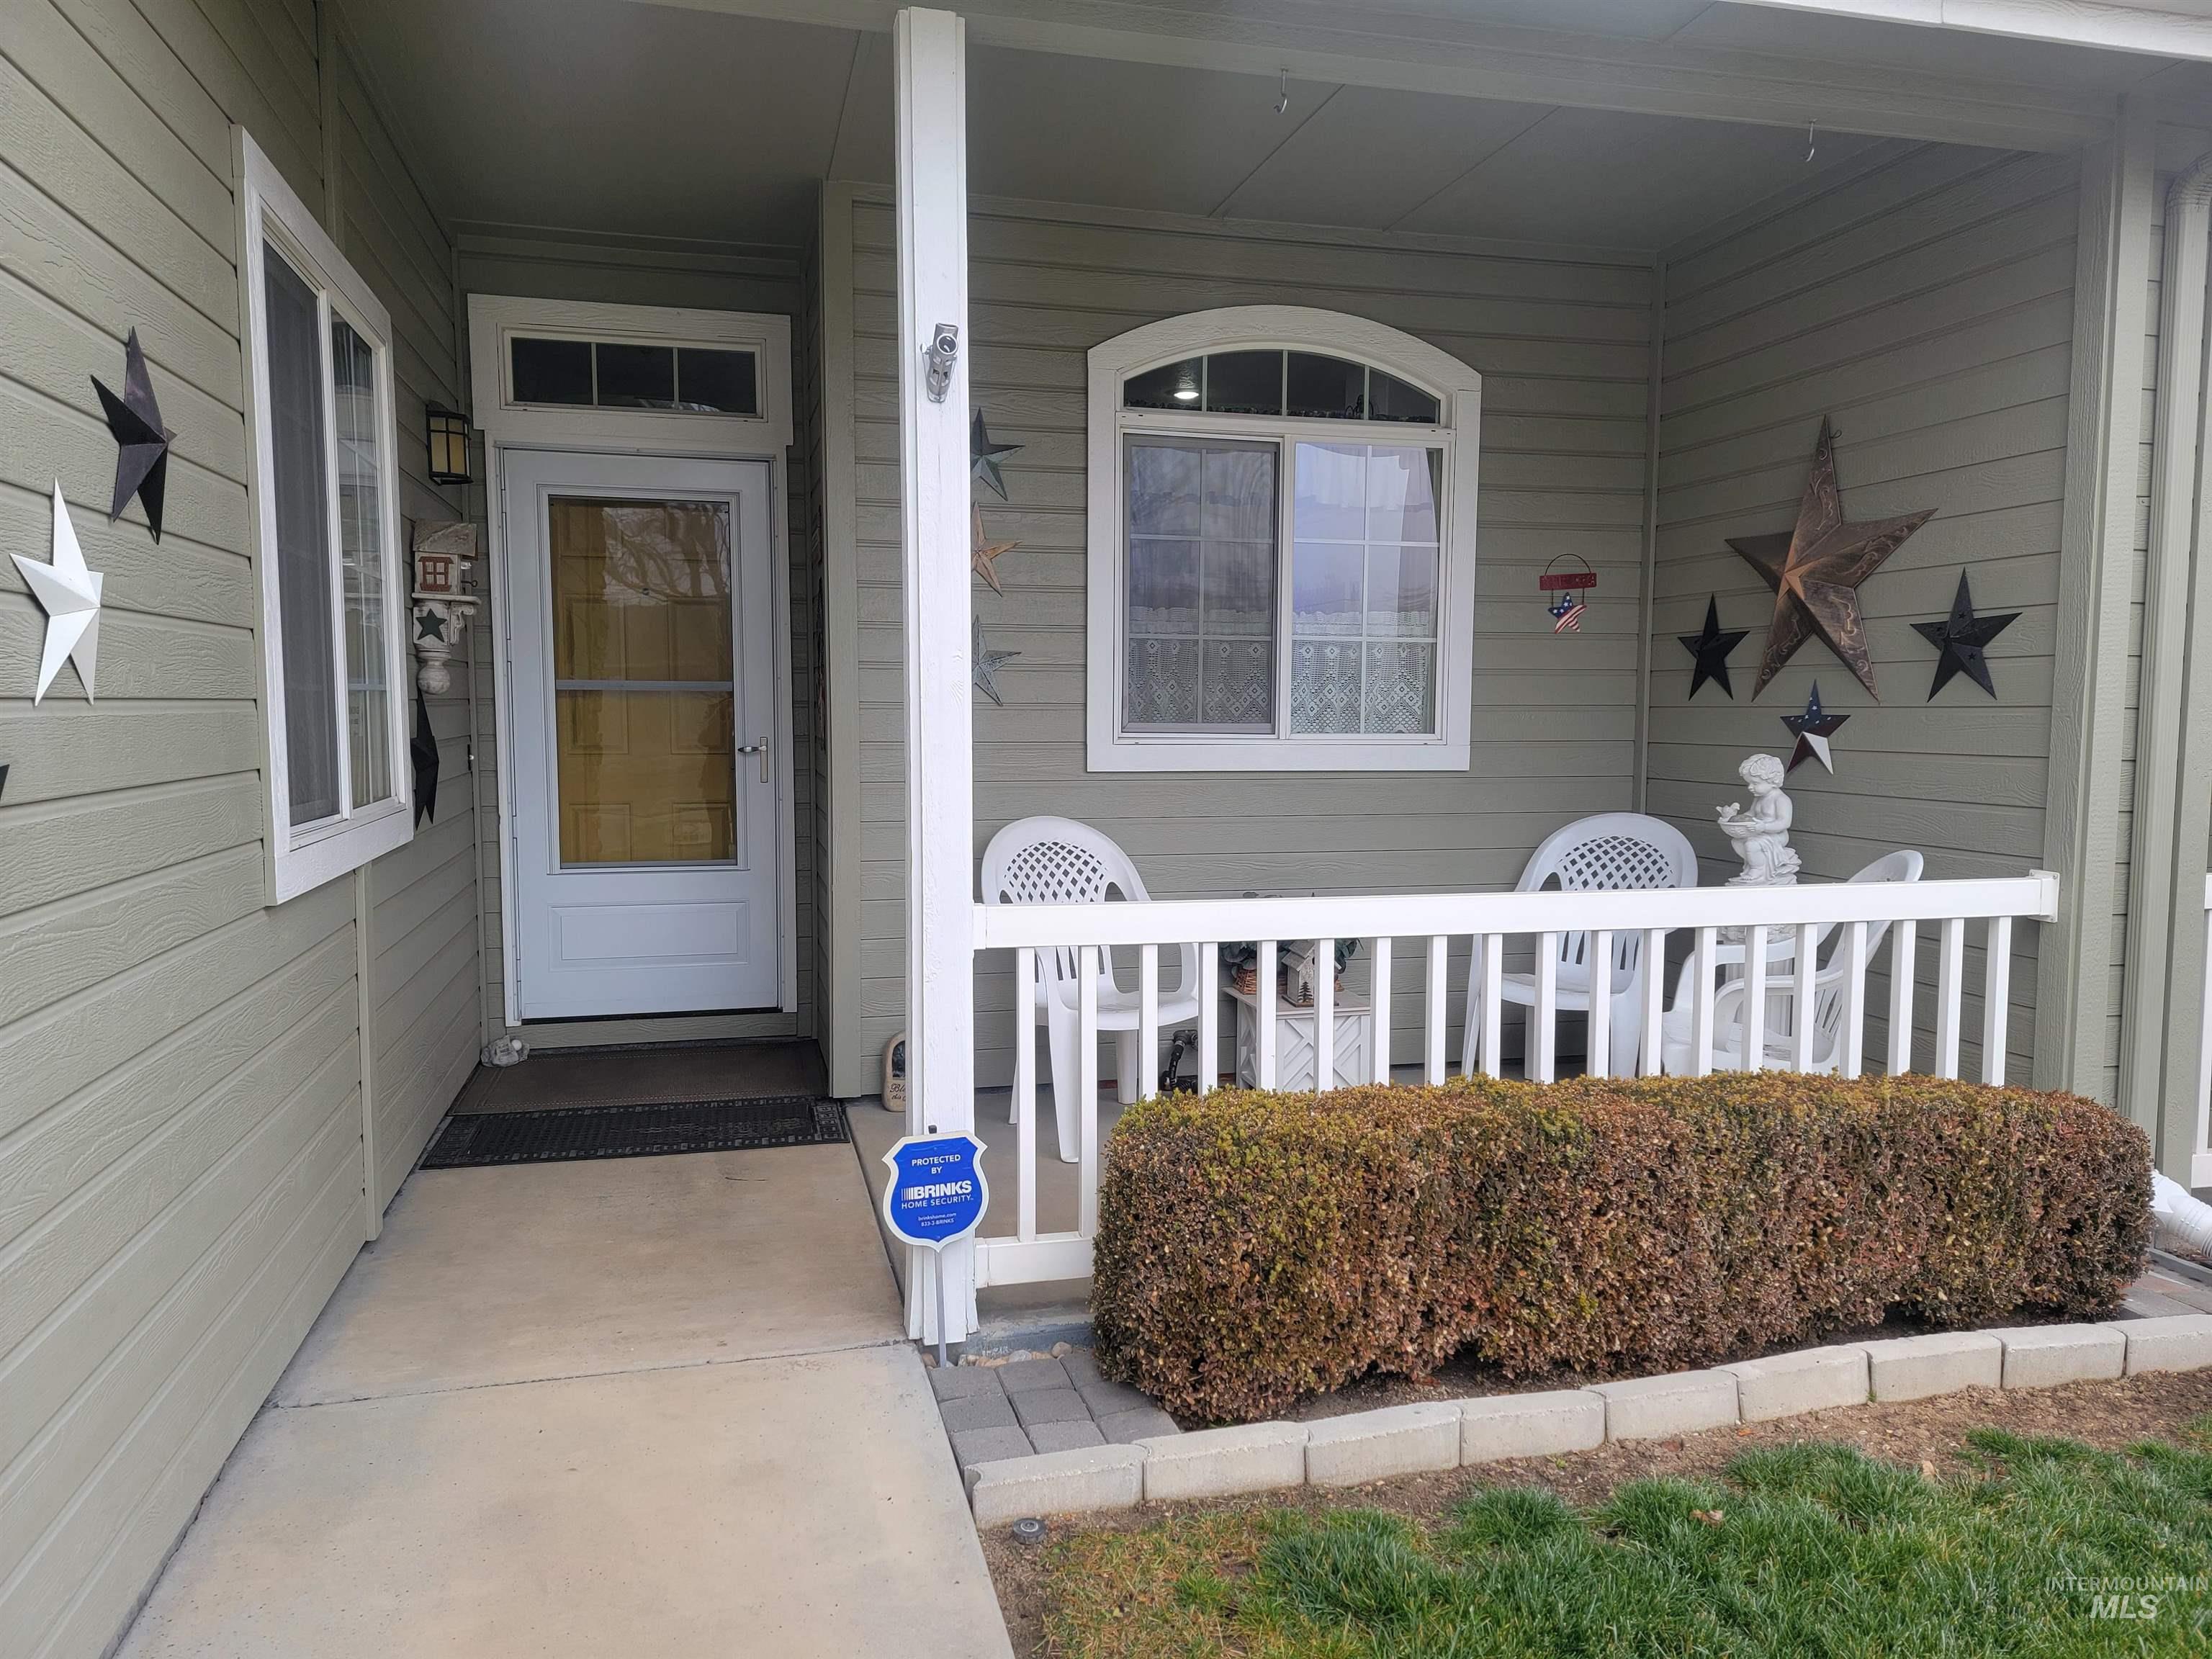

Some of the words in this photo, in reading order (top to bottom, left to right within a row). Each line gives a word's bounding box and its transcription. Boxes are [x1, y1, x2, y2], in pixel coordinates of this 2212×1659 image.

[912, 1154, 961, 1166] PROTECTED
[912, 1179, 972, 1200] BRINKS
[901, 1200, 928, 1210] HOME
[930, 1194, 971, 1206] SECURITY
[918, 1213, 957, 1221] brinkshome.com
[921, 1218, 955, 1227] 833-3-BRINKS
